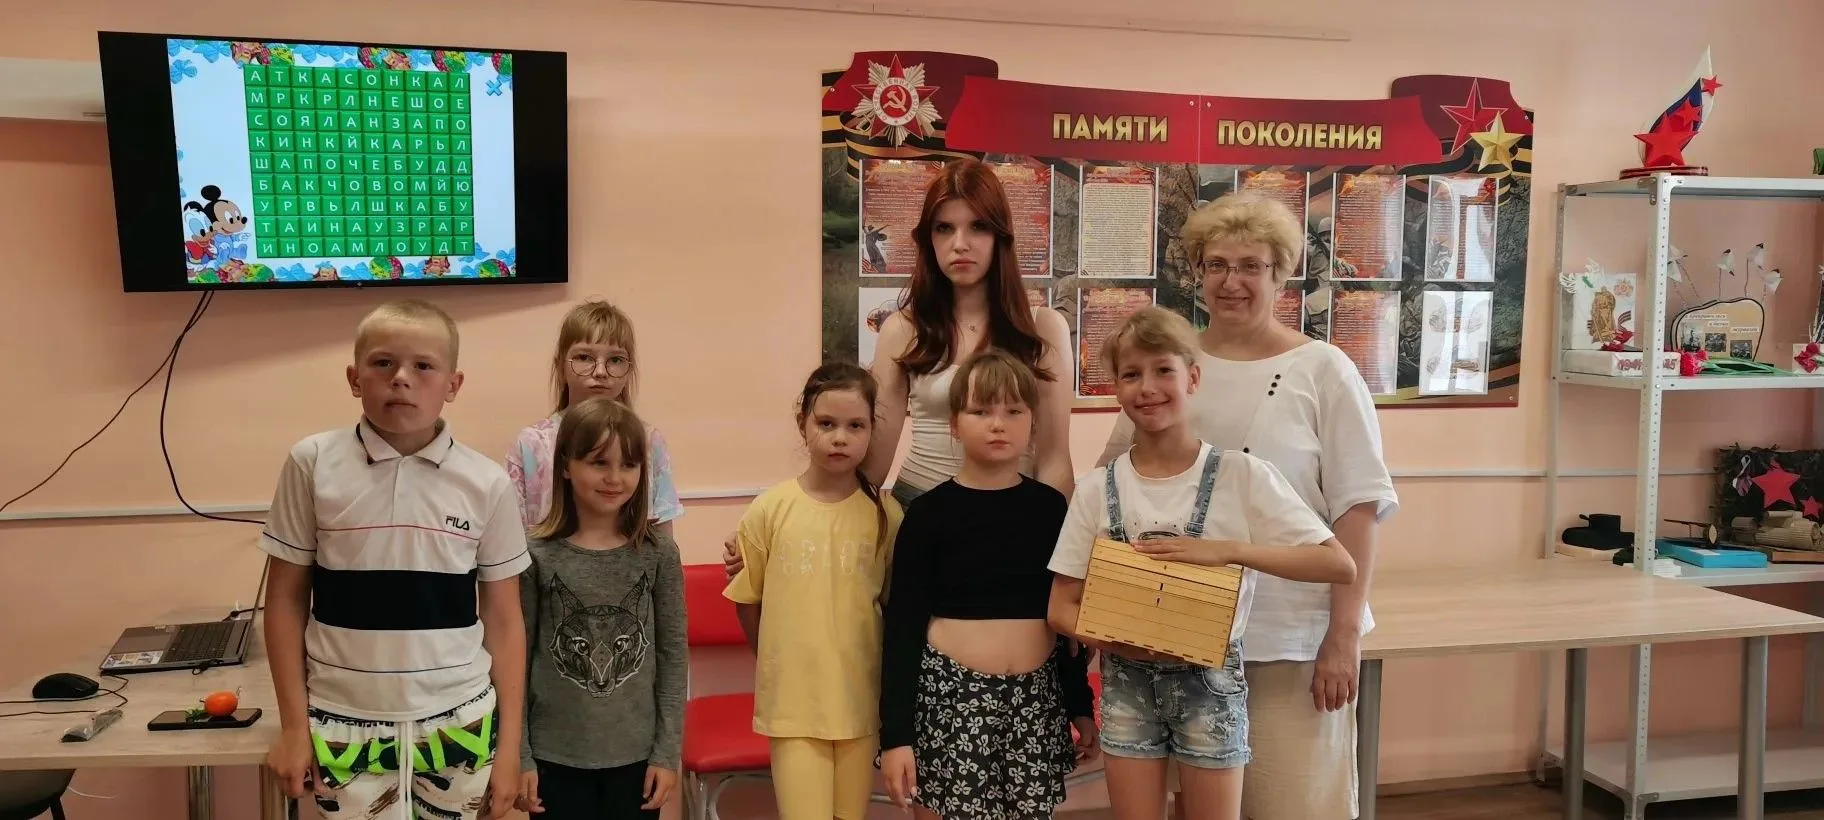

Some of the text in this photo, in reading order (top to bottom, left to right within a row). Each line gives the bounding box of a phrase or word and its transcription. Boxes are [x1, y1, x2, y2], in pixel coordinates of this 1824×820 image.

[250, 69, 465, 89] А Т К А С О Н К А Л
[250, 91, 465, 110] М Р К Р Л Н Е Ш О Е
[253, 113, 467, 131] С О Я Л А Н З А П О
[1052, 113, 1383, 150] ПАМЯТИ ПОКОЛЕНИЯ
[255, 135, 466, 151] К И Н К Й К А Р Ь Л
[255, 157, 468, 174] Ш А П О Ч Е Б У Д Д
[259, 178, 470, 193] Б А К Ч О В О М Й Ю
[259, 200, 468, 213] У Р В Ь Л Ш К А Б У
[261, 221, 469, 233] Т А И Н А У З Р А Р
[262, 241, 469, 255] И Н О А М Л О У Д Т
[445, 515, 470, 531] FILA
